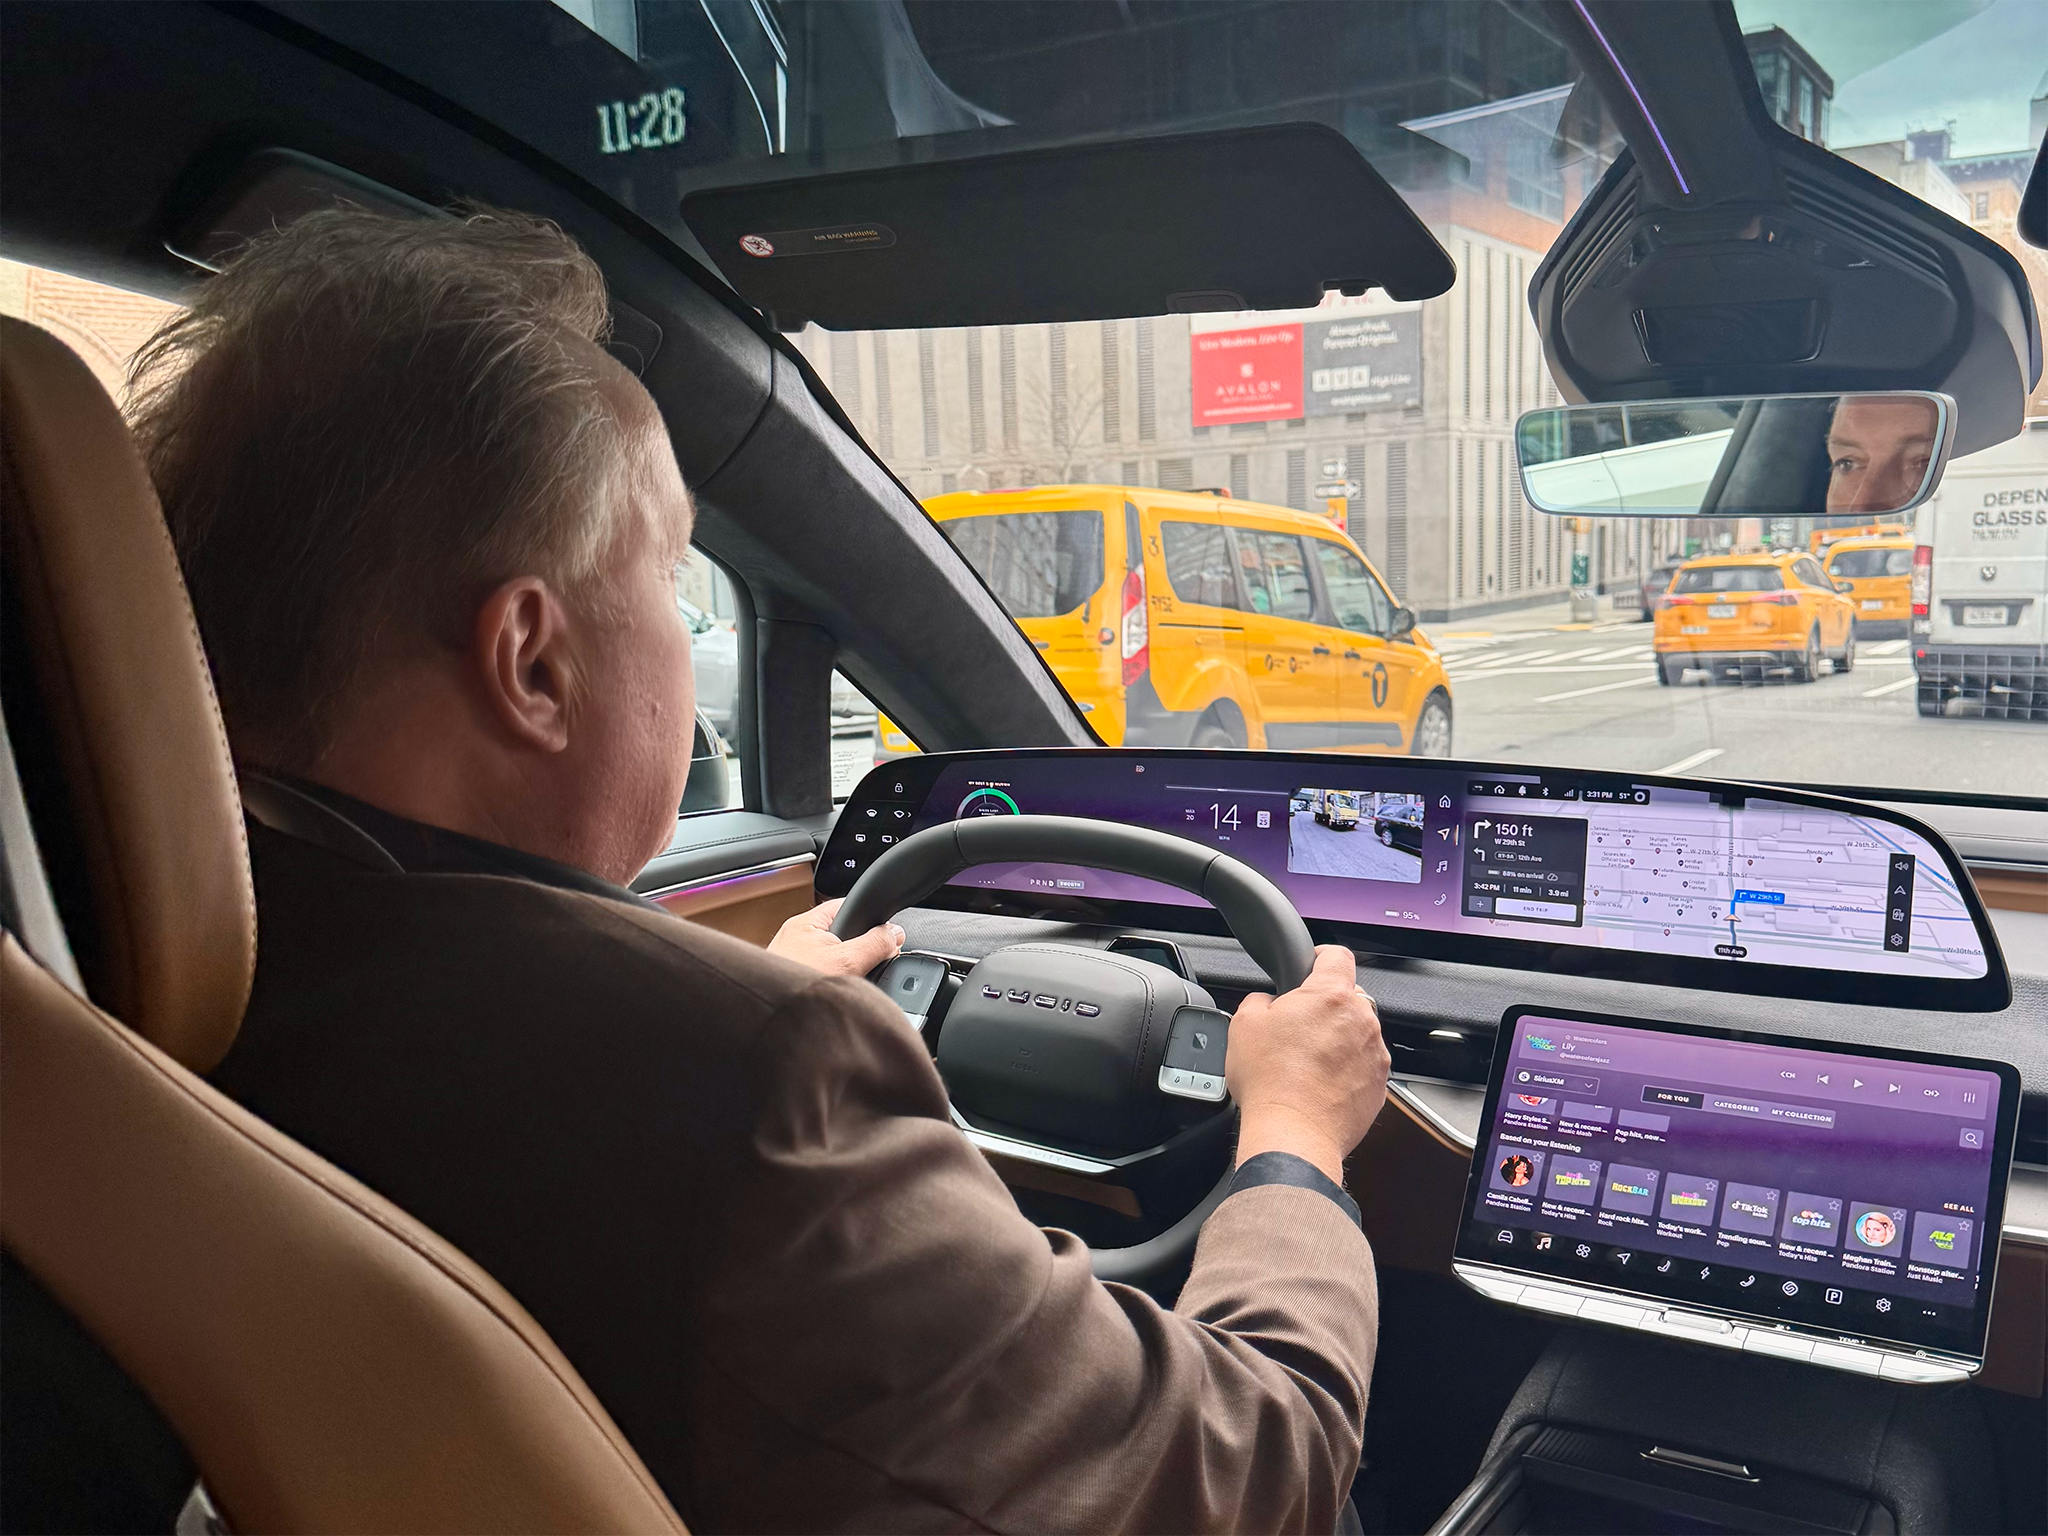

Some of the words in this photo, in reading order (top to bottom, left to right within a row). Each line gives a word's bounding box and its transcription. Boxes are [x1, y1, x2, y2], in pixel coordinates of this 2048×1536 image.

[597, 87, 686, 153] 11:28
[1215, 380, 1282, 397] AVALON
[1984, 488, 2048, 507] DEPEN
[1973, 510, 2032, 526] GLASS
[2035, 509, 2047, 525] &
[1210, 803, 1242, 831] 14
[1495, 823, 1518, 836] 150
[1521, 824, 1534, 837] ft
[1502, 838, 1517, 846] 29th
[1474, 882, 1489, 890] 3:42
[1490, 883, 1500, 891] PM
[1548, 889, 1559, 897] 3.9
[1403, 911, 1420, 920] 95%
[1731, 948, 1745, 956] Ave
[1573, 1036, 1607, 1045] Watercolors
[1562, 1043, 1575, 1051] Lily
[1534, 1075, 1565, 1085] SiriusXM
[1657, 1093, 1672, 1101] FOR
[1714, 1101, 1759, 1112] CATEGORIES
[1504, 1111, 1521, 1120] Harry
[1522, 1114, 1541, 1122] Styles
[1784, 1110, 1832, 1122] COLLECTION
[1503, 1118, 1527, 1127] Pandora
[1559, 1120, 1574, 1128] New
[1580, 1124, 1602, 1132] recent
[1558, 1127, 1575, 1135] Music
[1615, 1128, 1629, 1137] Pop
[1500, 1133, 1522, 1142] Based
[1533, 1138, 1549, 1148] your
[1549, 1141, 1581, 1153] listening
[1612, 1182, 1649, 1196] ROCKBAR
[1486, 1191, 1508, 1201] Camila
[1671, 1194, 1708, 1207] WORKOUT
[1485, 1199, 1509, 1208] Pandora
[1510, 1203, 1531, 1212] Station
[1542, 1201, 1557, 1210] New
[1563, 1206, 1585, 1215] recent
[1741, 1203, 1769, 1215] TikTok
[1943, 1202, 1958, 1210] SEE
[1960, 1205, 1974, 1213] ALL
[1541, 1209, 1563, 1218] Today's
[1599, 1212, 1615, 1221] Hard
[1616, 1215, 1631, 1223] rock
[1598, 1219, 1613, 1227] Rock
[1658, 1221, 1683, 1232] Today's
[1792, 1216, 1810, 1226] top
[1810, 1218, 1831, 1229] hits
[1656, 1229, 1683, 1239] Workout
[1718, 1232, 1748, 1244] Trending
[1716, 1239, 1730, 1248] Pop
[1779, 1243, 1796, 1252] New
[1803, 1248, 1828, 1257] recent
[1778, 1250, 1803, 1260] Today's
[1804, 1254, 1818, 1262] Hits
[1842, 1253, 1873, 1264] Meghan
[1841, 1261, 1869, 1272] Pandora
[1870, 1266, 1895, 1276] Station
[1908, 1264, 1940, 1277] Nonstop
[1907, 1272, 1921, 1280] Just
[1922, 1274, 1943, 1284] Music
